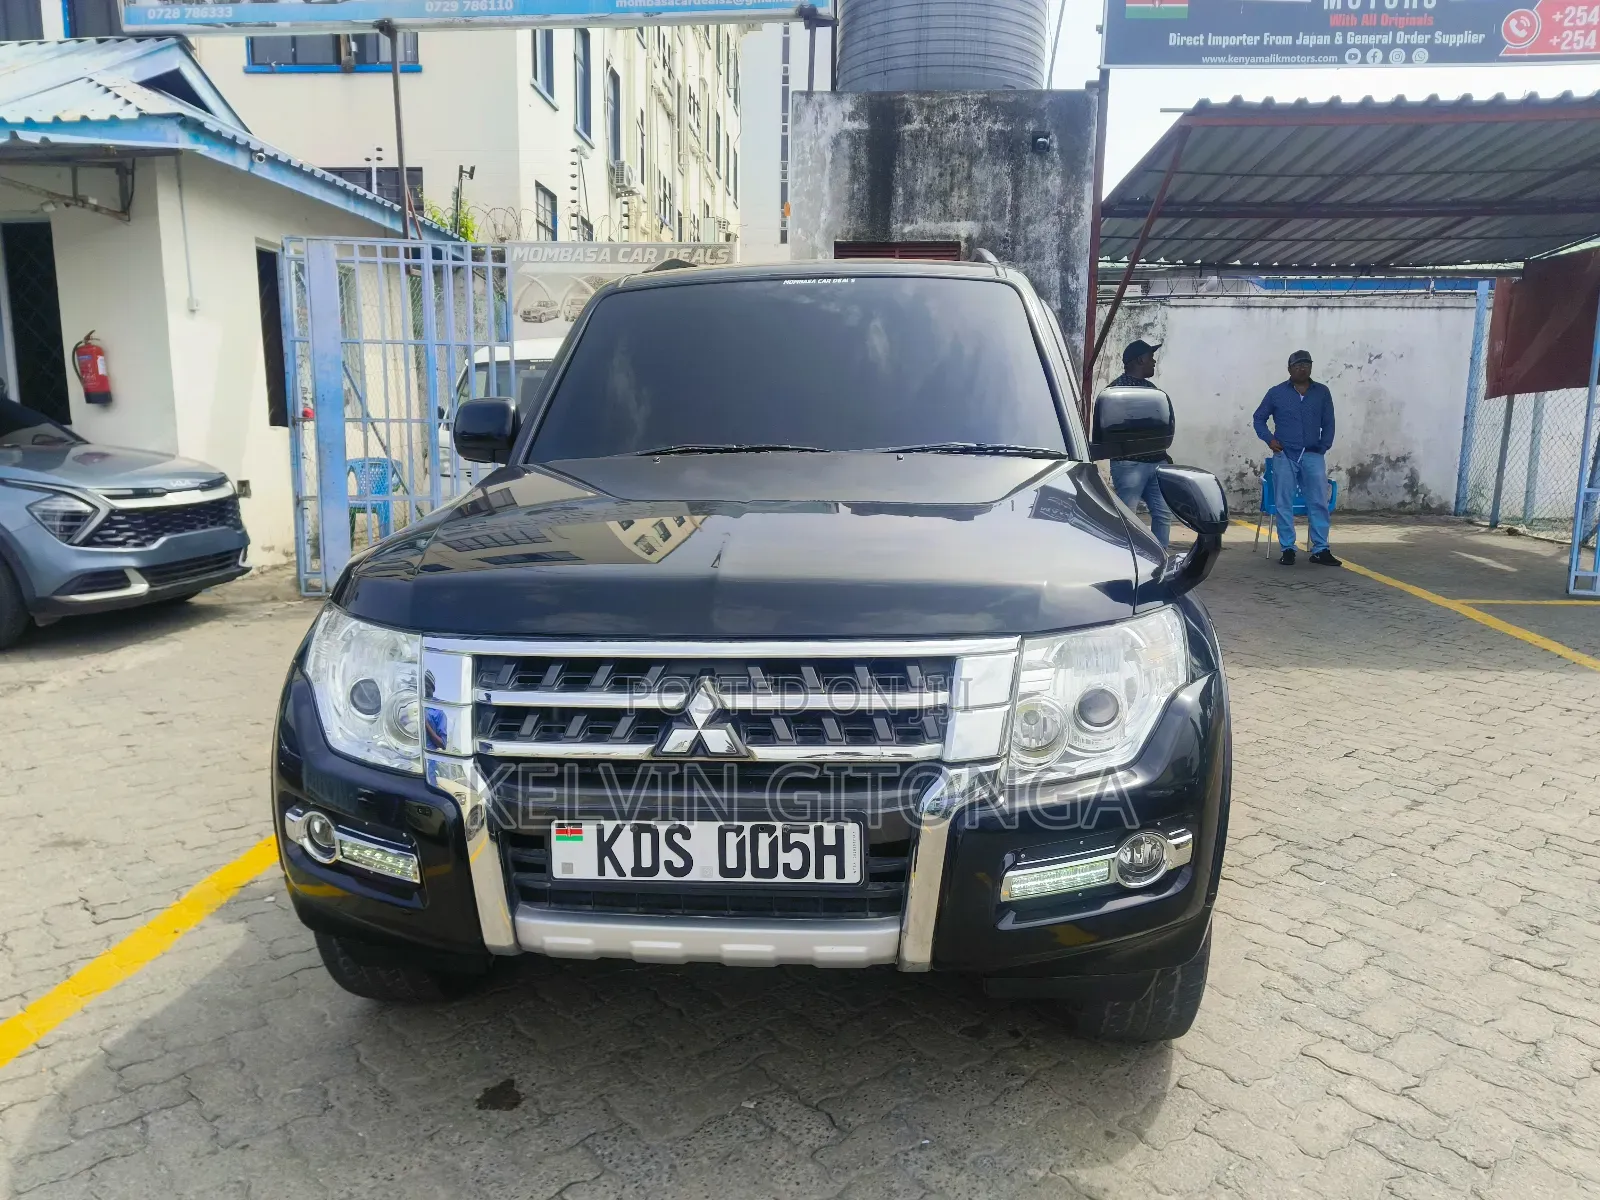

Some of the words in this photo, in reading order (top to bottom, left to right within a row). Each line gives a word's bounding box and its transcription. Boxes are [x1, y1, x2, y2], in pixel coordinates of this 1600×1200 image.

[147, 8, 180, 19] 0728
[184, 6, 233, 19] 786333
[425, 1, 459, 12] 0729
[462, 0, 514, 11] 786110
[1329, 13, 1358, 27] With
[1361, 13, 1377, 27] All
[1381, 12, 1434, 28] Originals
[1551, 5, 1600, 27] +254
[1168, 33, 1204, 46] Direct
[1207, 33, 1260, 48] Importer
[1263, 33, 1292, 46] From
[1296, 32, 1331, 48] Japan
[1334, 33, 1343, 45] &
[1347, 31, 1393, 45] General
[1396, 31, 1431, 45] Order
[1434, 30, 1486, 47] Supplier
[1549, 29, 1597, 50] +254
[1201, 53, 1338, 65] www.kenyamalikmotors.com
[511, 246, 611, 263] MOMBASA
[617, 247, 657, 264] CAR
[664, 247, 730, 264] DEALS
[597, 823, 694, 878] KDS
[718, 823, 846, 880] 005H
